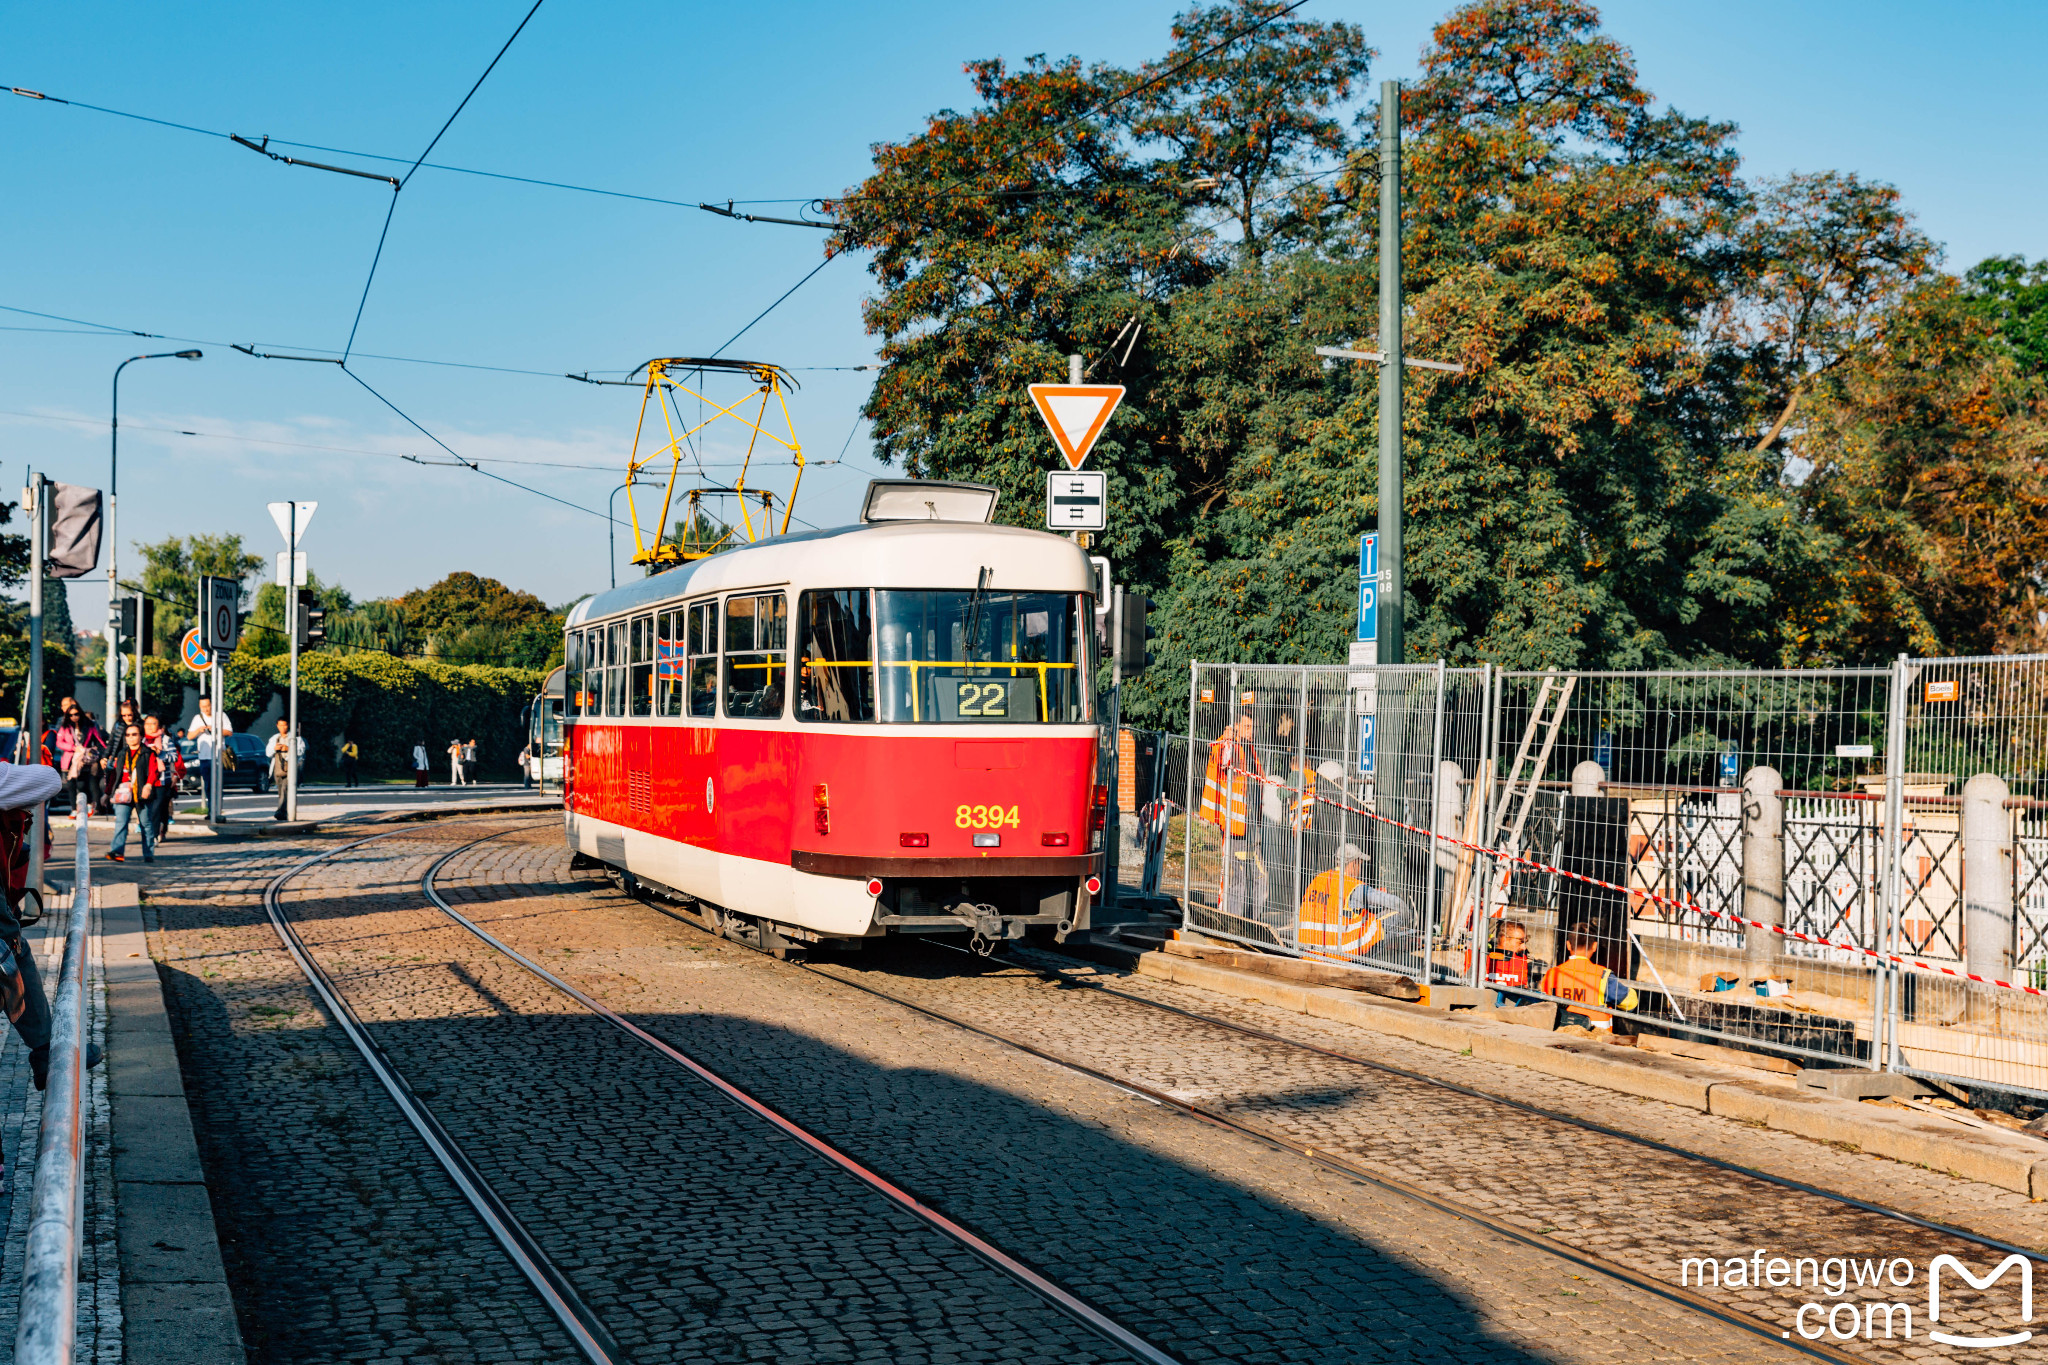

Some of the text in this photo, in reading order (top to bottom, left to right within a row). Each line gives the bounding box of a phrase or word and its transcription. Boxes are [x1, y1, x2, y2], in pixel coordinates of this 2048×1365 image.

[1361, 587, 1374, 622] P
[958, 683, 1006, 716] 22
[955, 804, 1021, 829] 8394
